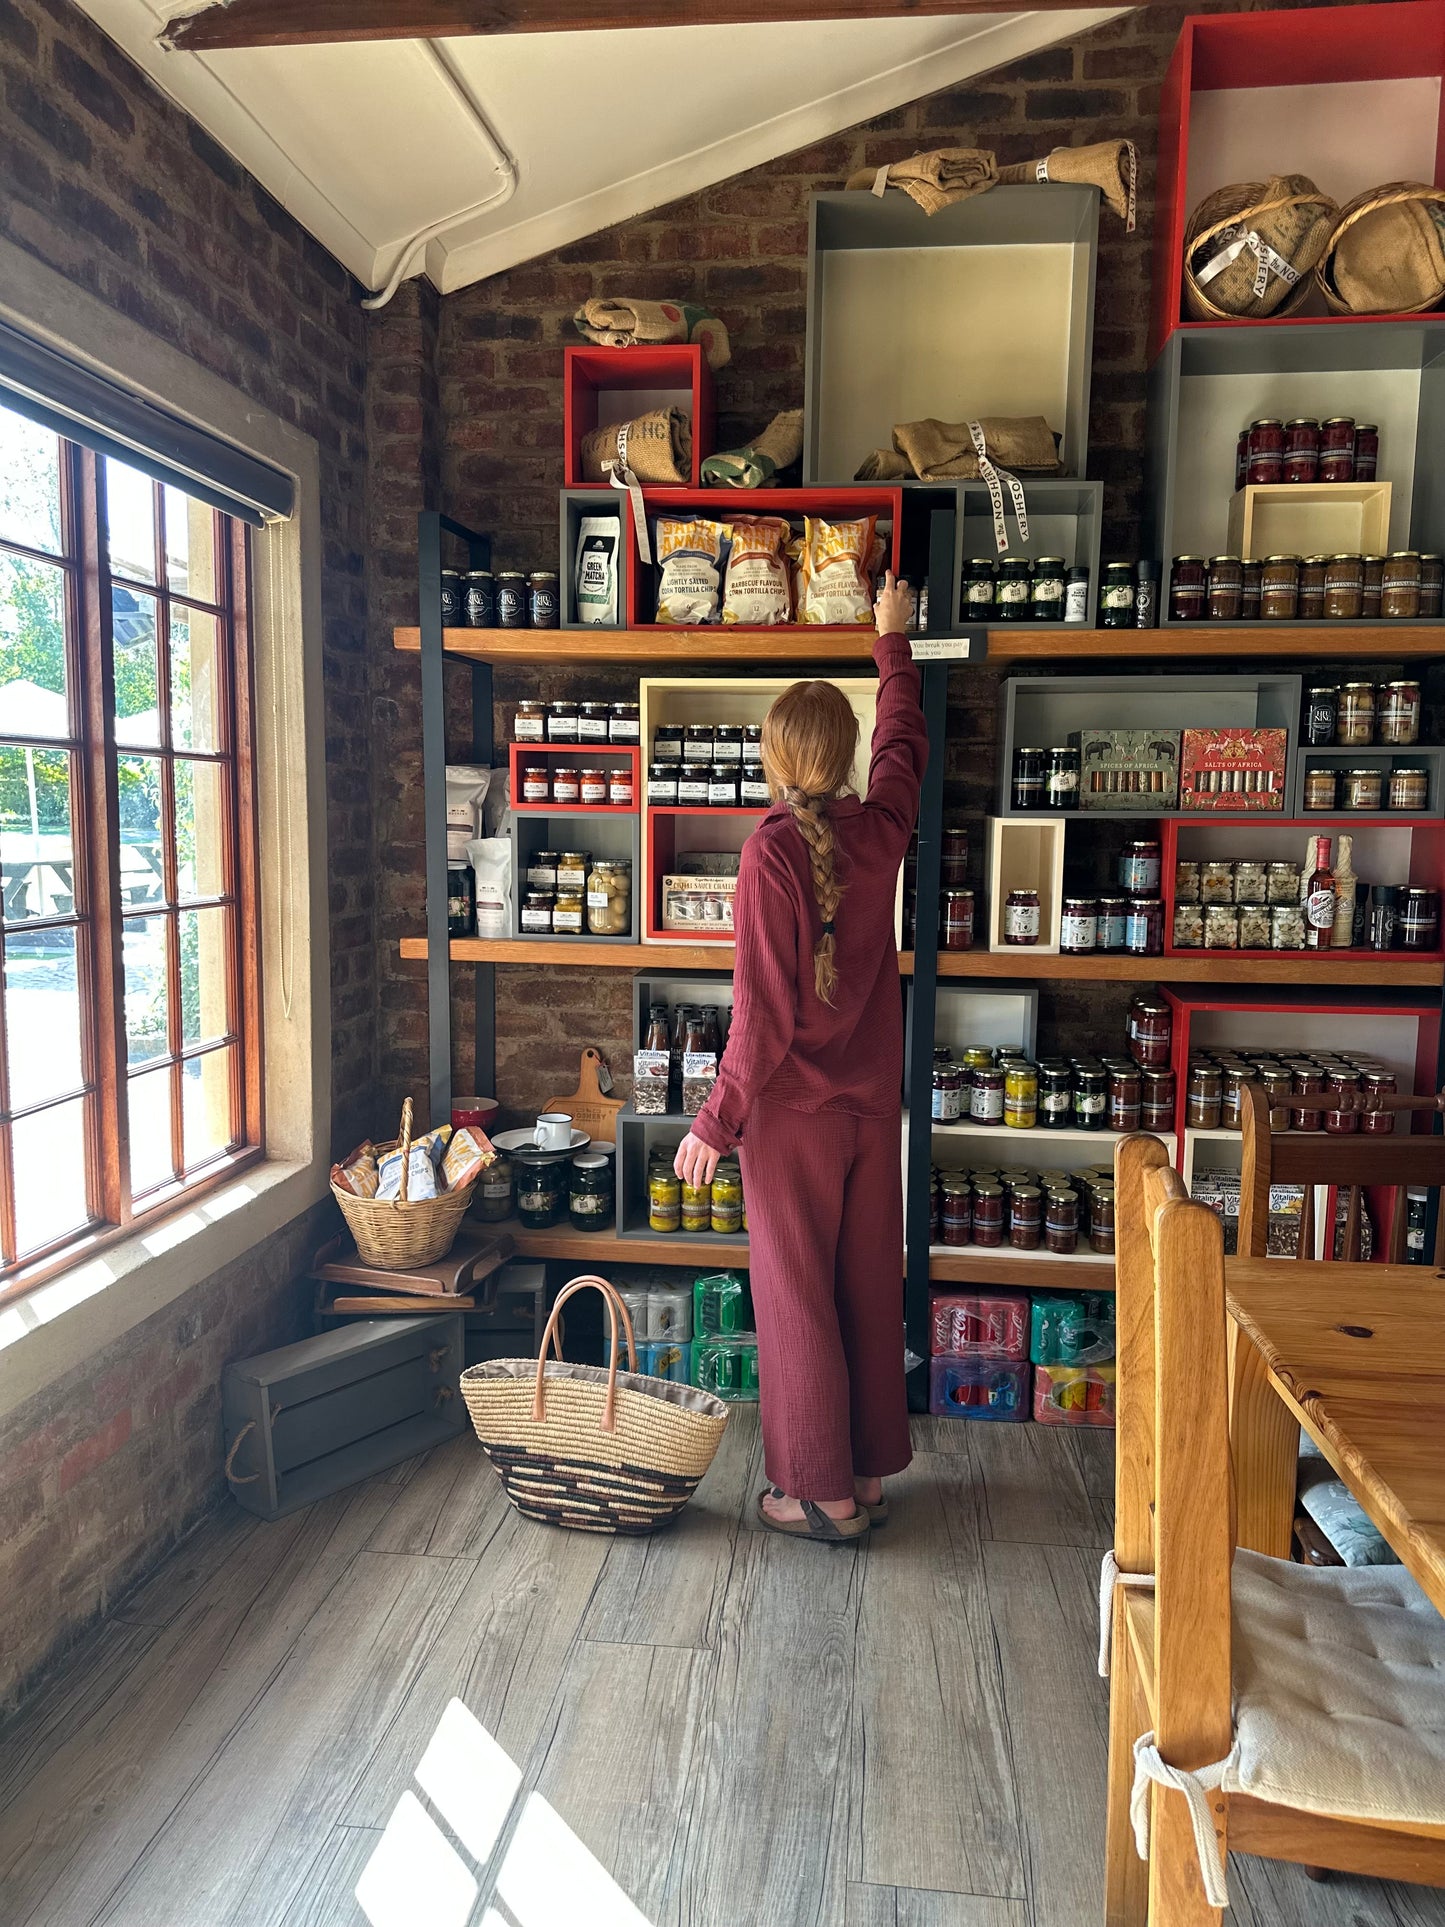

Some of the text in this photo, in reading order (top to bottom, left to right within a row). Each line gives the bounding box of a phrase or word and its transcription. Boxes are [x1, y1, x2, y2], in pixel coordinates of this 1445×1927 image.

[982, 466, 1003, 520] NOSHERY
[586, 562, 602, 571] GREEN
[584, 570, 605, 581] MATCHA
[666, 578, 708, 586] LIGHTLY SALTED
[731, 579, 783, 589] BARBECUE FLAVOUR
[729, 588, 743, 597] CORN
[770, 587, 786, 596] CHIPS
[818, 584, 838, 593] CHEESE
[810, 591, 826, 600] CORN
[686, 1058, 710, 1066] Vitality
[411, 1168, 429, 1176] CHIPS
[1192, 1194, 1217, 1202] Vitality
[1272, 1194, 1298, 1202] Vitality
